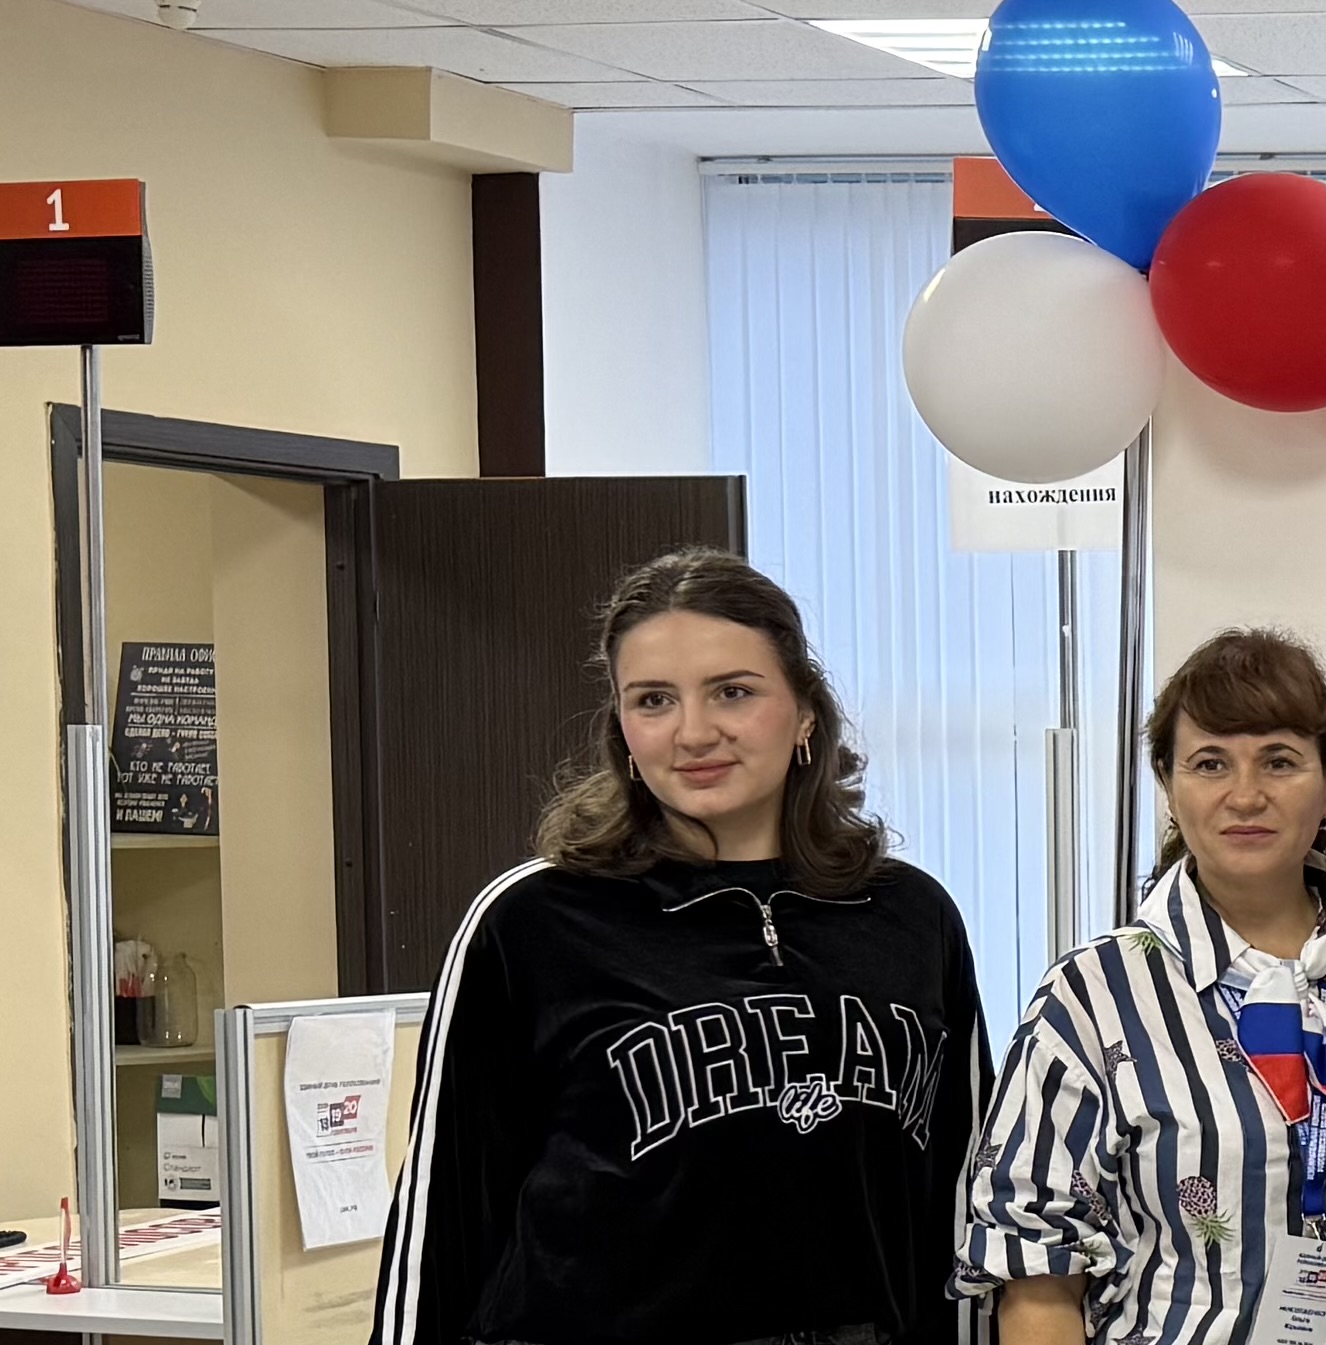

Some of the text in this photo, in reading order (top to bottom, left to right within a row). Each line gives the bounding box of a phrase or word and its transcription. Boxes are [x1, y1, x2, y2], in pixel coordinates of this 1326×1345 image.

[46, 188, 70, 231] 1
[988, 487, 1116, 507] нахождения
[606, 993, 949, 1162] DREAM
[344, 1101, 357, 1114] 20
[780, 1081, 840, 1133] life
